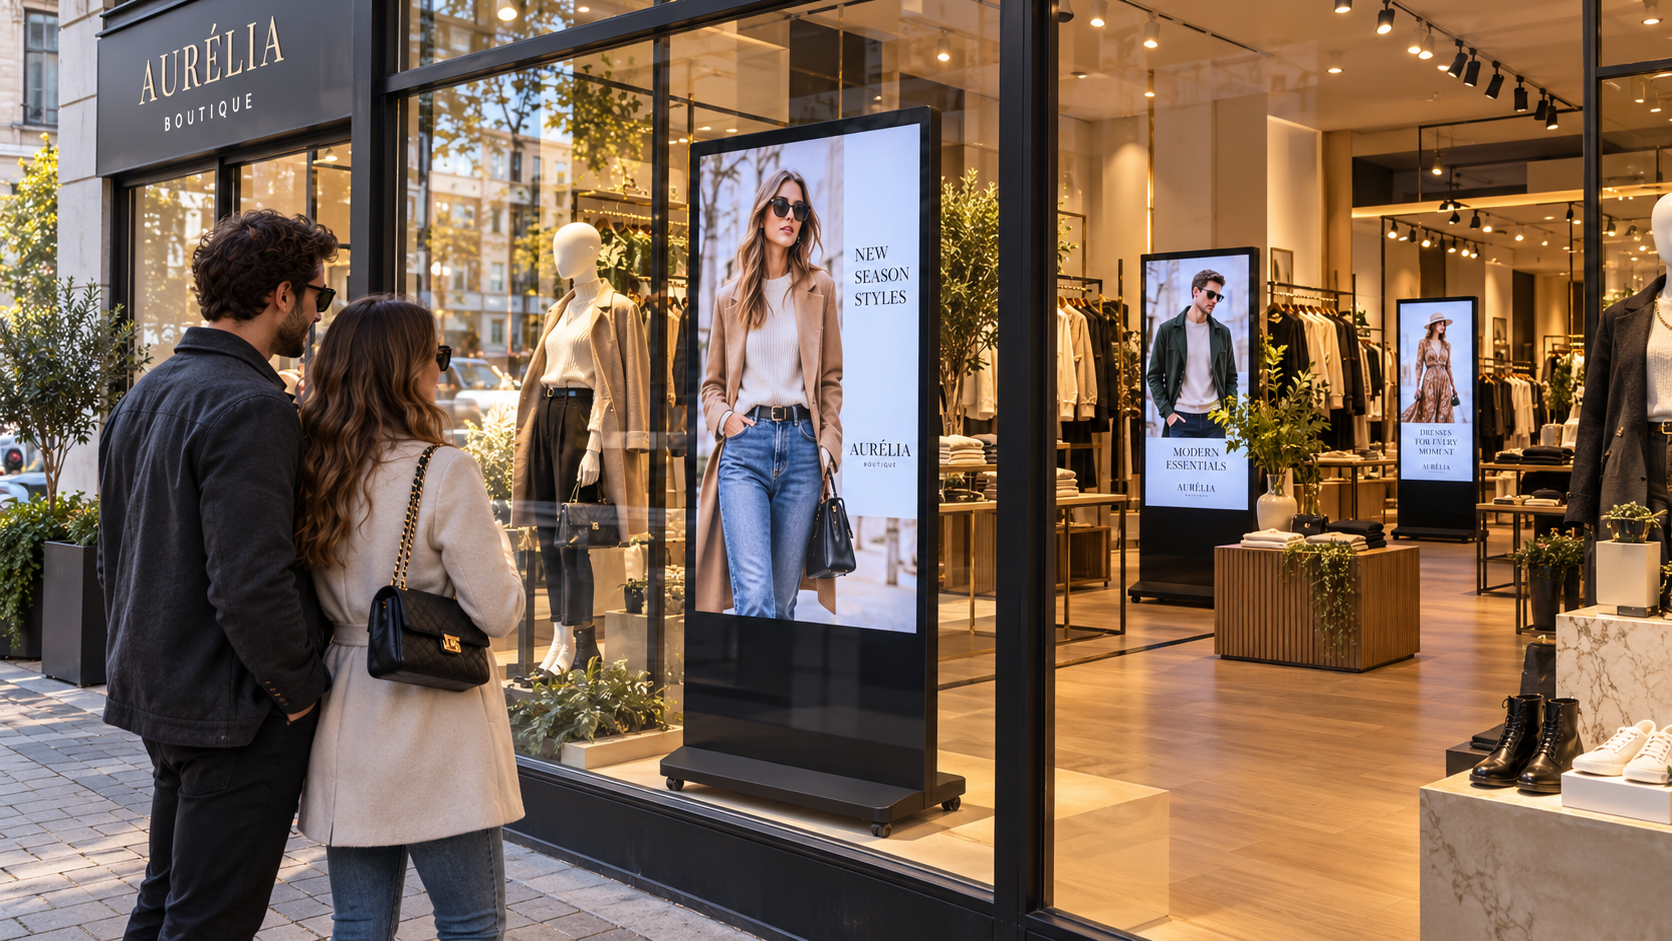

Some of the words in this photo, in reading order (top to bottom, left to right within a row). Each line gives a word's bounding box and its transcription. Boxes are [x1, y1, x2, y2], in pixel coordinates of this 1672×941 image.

[139, 15, 285, 105] AURÉLIA
[164, 93, 253, 131] BOUTIQUE
[855, 245, 889, 262] NEW
[855, 266, 910, 284] SEASON
[855, 290, 907, 306] STYLES
[850, 438, 911, 457] AURÉLIA
[1173, 447, 1219, 457] MODERN
[1419, 448, 1454, 456] MOMENT
[1166, 460, 1227, 471] ESSENTIALS
[1177, 482, 1216, 493] AURÉLIA
